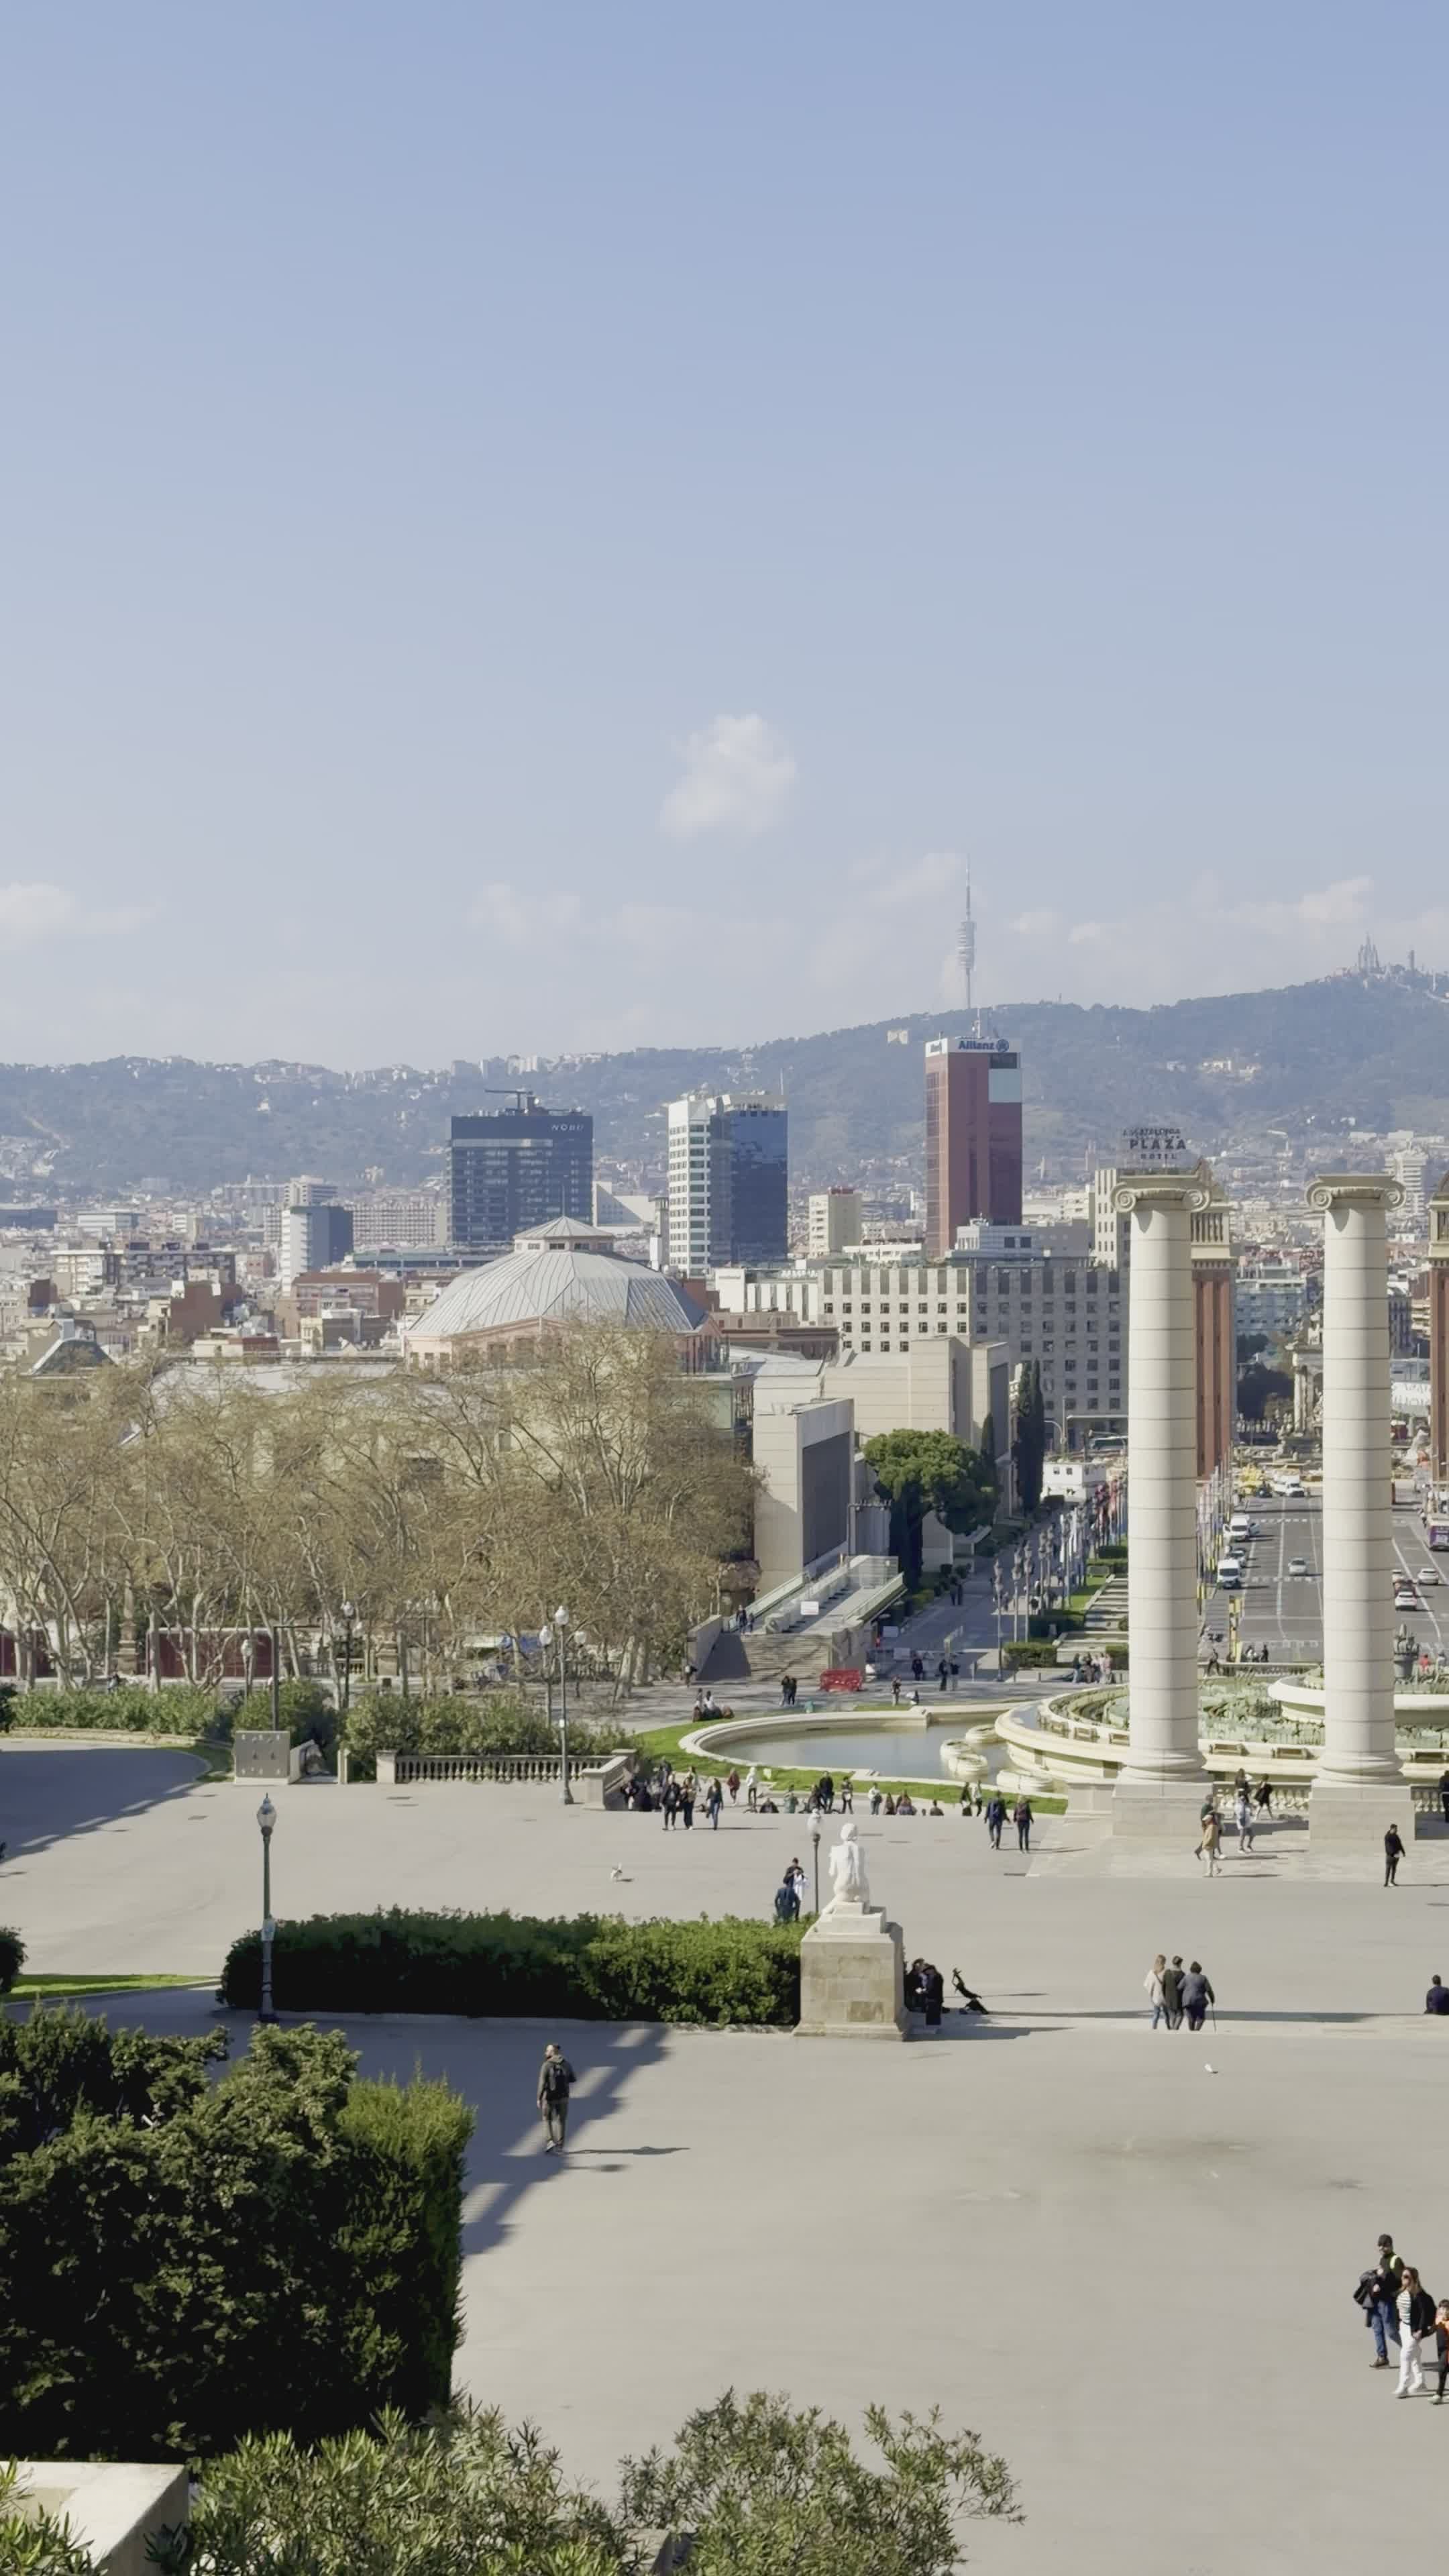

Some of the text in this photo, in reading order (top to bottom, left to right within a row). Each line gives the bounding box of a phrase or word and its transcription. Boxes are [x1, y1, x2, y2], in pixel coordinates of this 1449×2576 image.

[958, 1040, 994, 1051] Allianz
[551, 1124, 585, 1132] NOBU
[1129, 1138, 1187, 1149] PLAZA
